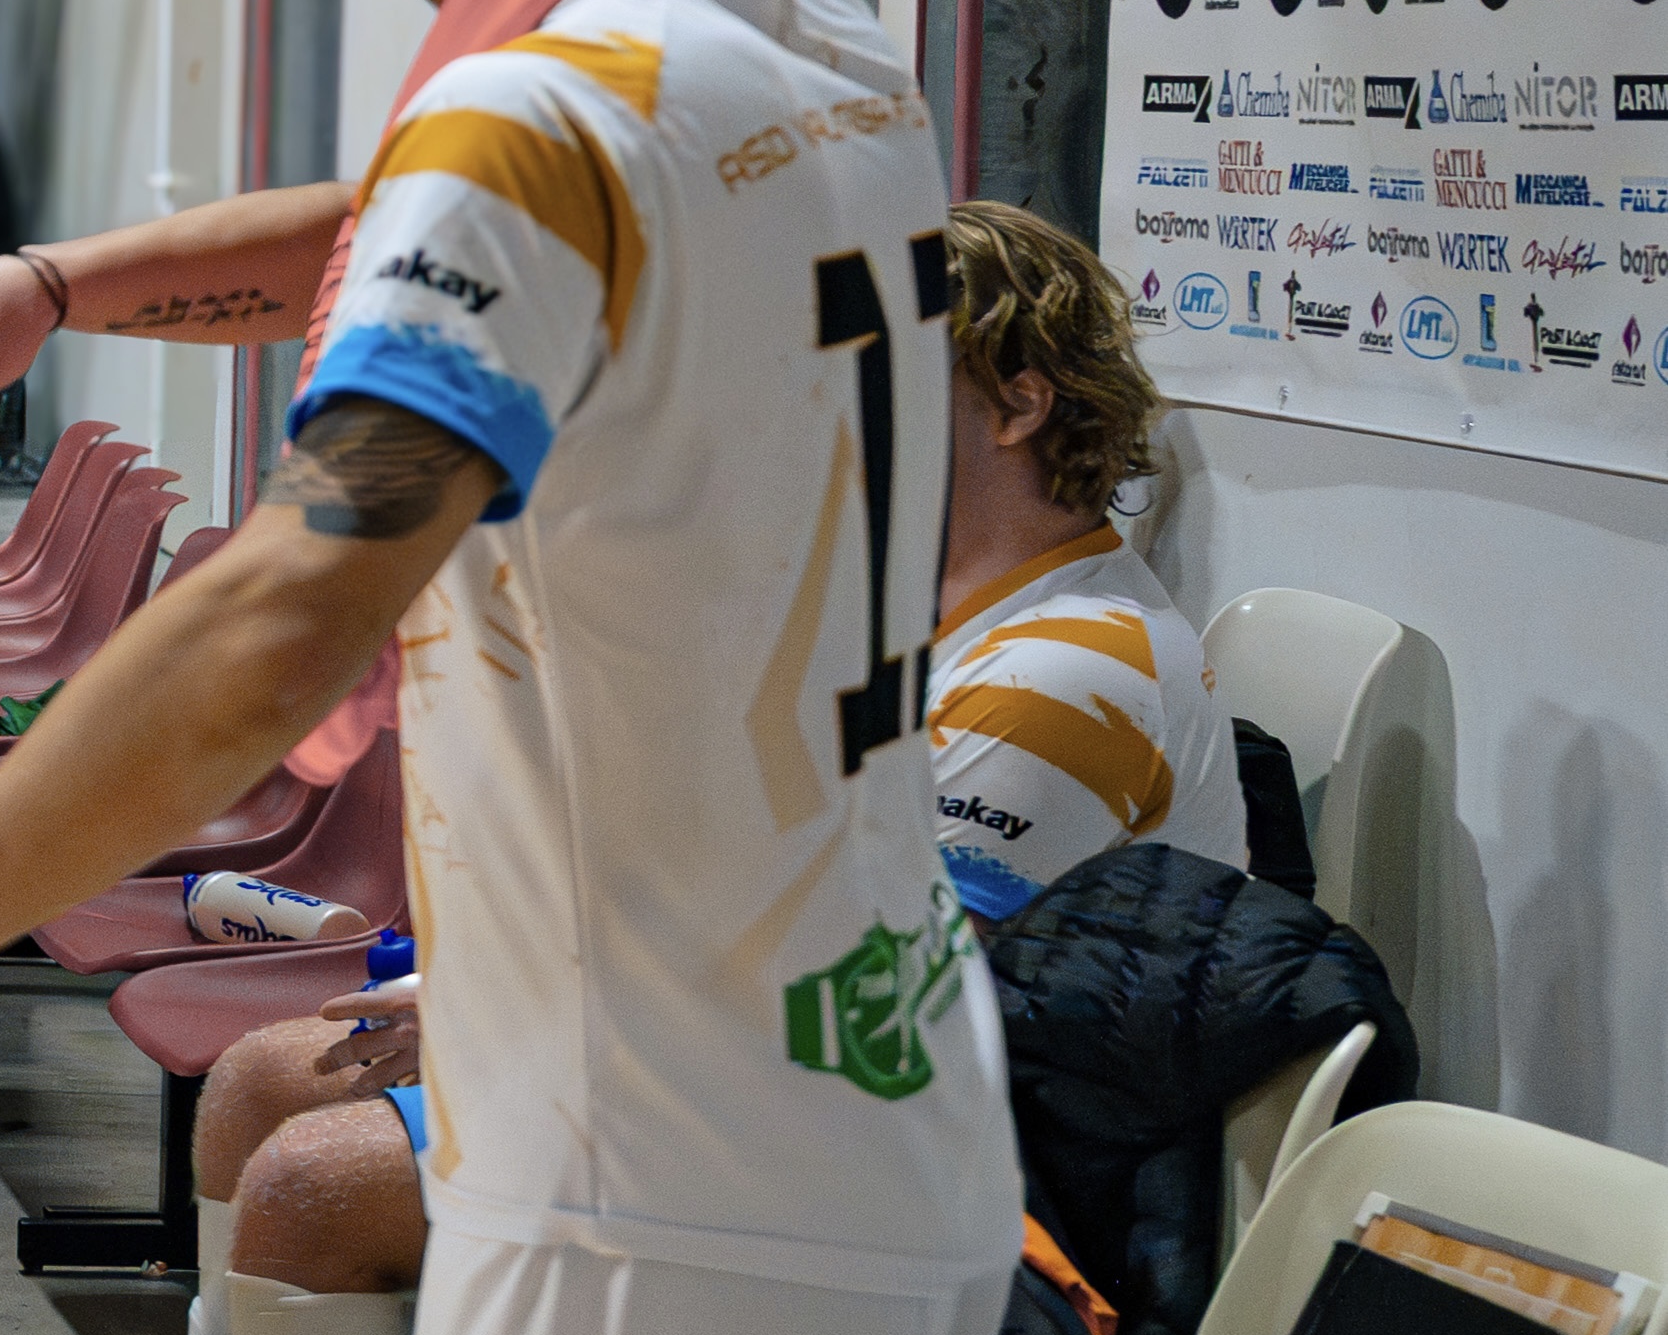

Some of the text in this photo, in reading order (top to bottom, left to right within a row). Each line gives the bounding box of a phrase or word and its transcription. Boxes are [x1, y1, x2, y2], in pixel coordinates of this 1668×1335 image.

[1145, 82, 1197, 106] ARMA
[1366, 84, 1406, 110] ARMA
[1218, 140, 1264, 167] GATTI &
[1434, 149, 1487, 178] GATTI &
[1217, 167, 1283, 196] MENCUCCI
[1434, 179, 1507, 210] MENCUCCI
